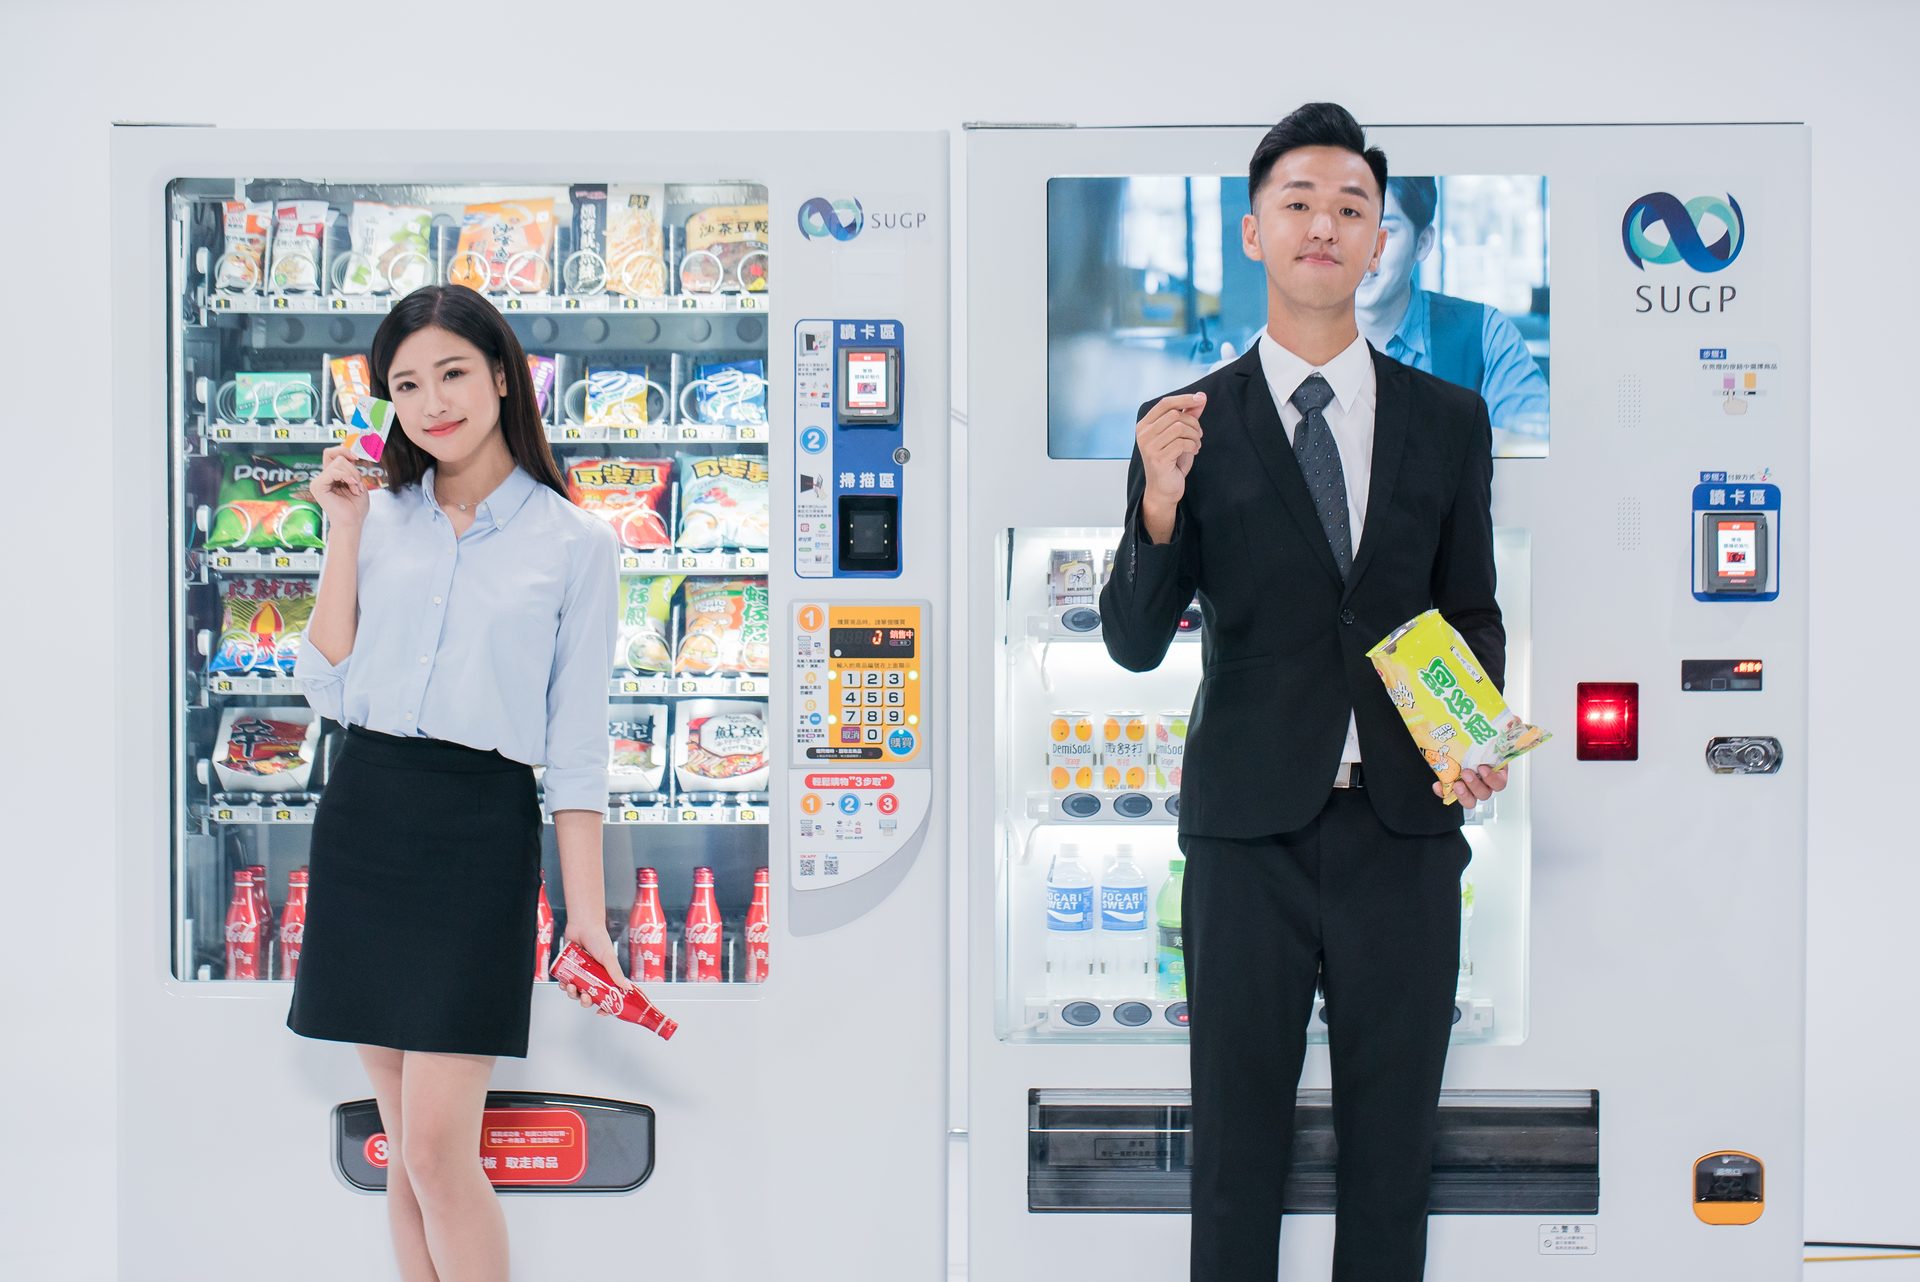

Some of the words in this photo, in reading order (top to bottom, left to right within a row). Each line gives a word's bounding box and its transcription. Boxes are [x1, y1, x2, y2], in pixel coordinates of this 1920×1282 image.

[871, 213, 926, 229] SUGP
[1636, 285, 1737, 313] SUGP
[840, 324, 895, 340] 讀卡區
[807, 431, 820, 449] 2
[839, 472, 895, 489] 掃描區
[1710, 489, 1766, 505] 讀卡區
[804, 610, 815, 627] 1
[890, 630, 914, 639] 銷售中
[847, 673, 853, 685] 1
[867, 673, 878, 685] 2
[889, 673, 899, 685] 3
[845, 692, 856, 703] 4
[867, 692, 877, 703] 5
[888, 692, 899, 703] 6
[845, 711, 856, 722] 7
[867, 711, 878, 722] 8
[889, 711, 899, 722] 9
[715, 724, 762, 740] 魷魚
[867, 729, 878, 740] 0
[1052, 743, 1091, 754] DemiSoda
[806, 797, 815, 811] 1
[845, 798, 855, 811] 2
[883, 797, 893, 811] 3
[1048, 892, 1082, 902] OCARI
[1102, 891, 1143, 902] POCARI
[1048, 901, 1078, 910] WEAT
[1102, 900, 1140, 910] SWEAT
[633, 922, 666, 944] Cola
[688, 922, 722, 944] Cola
[374, 1140, 389, 1160] 3
[505, 1156, 559, 1169] 取走商品
